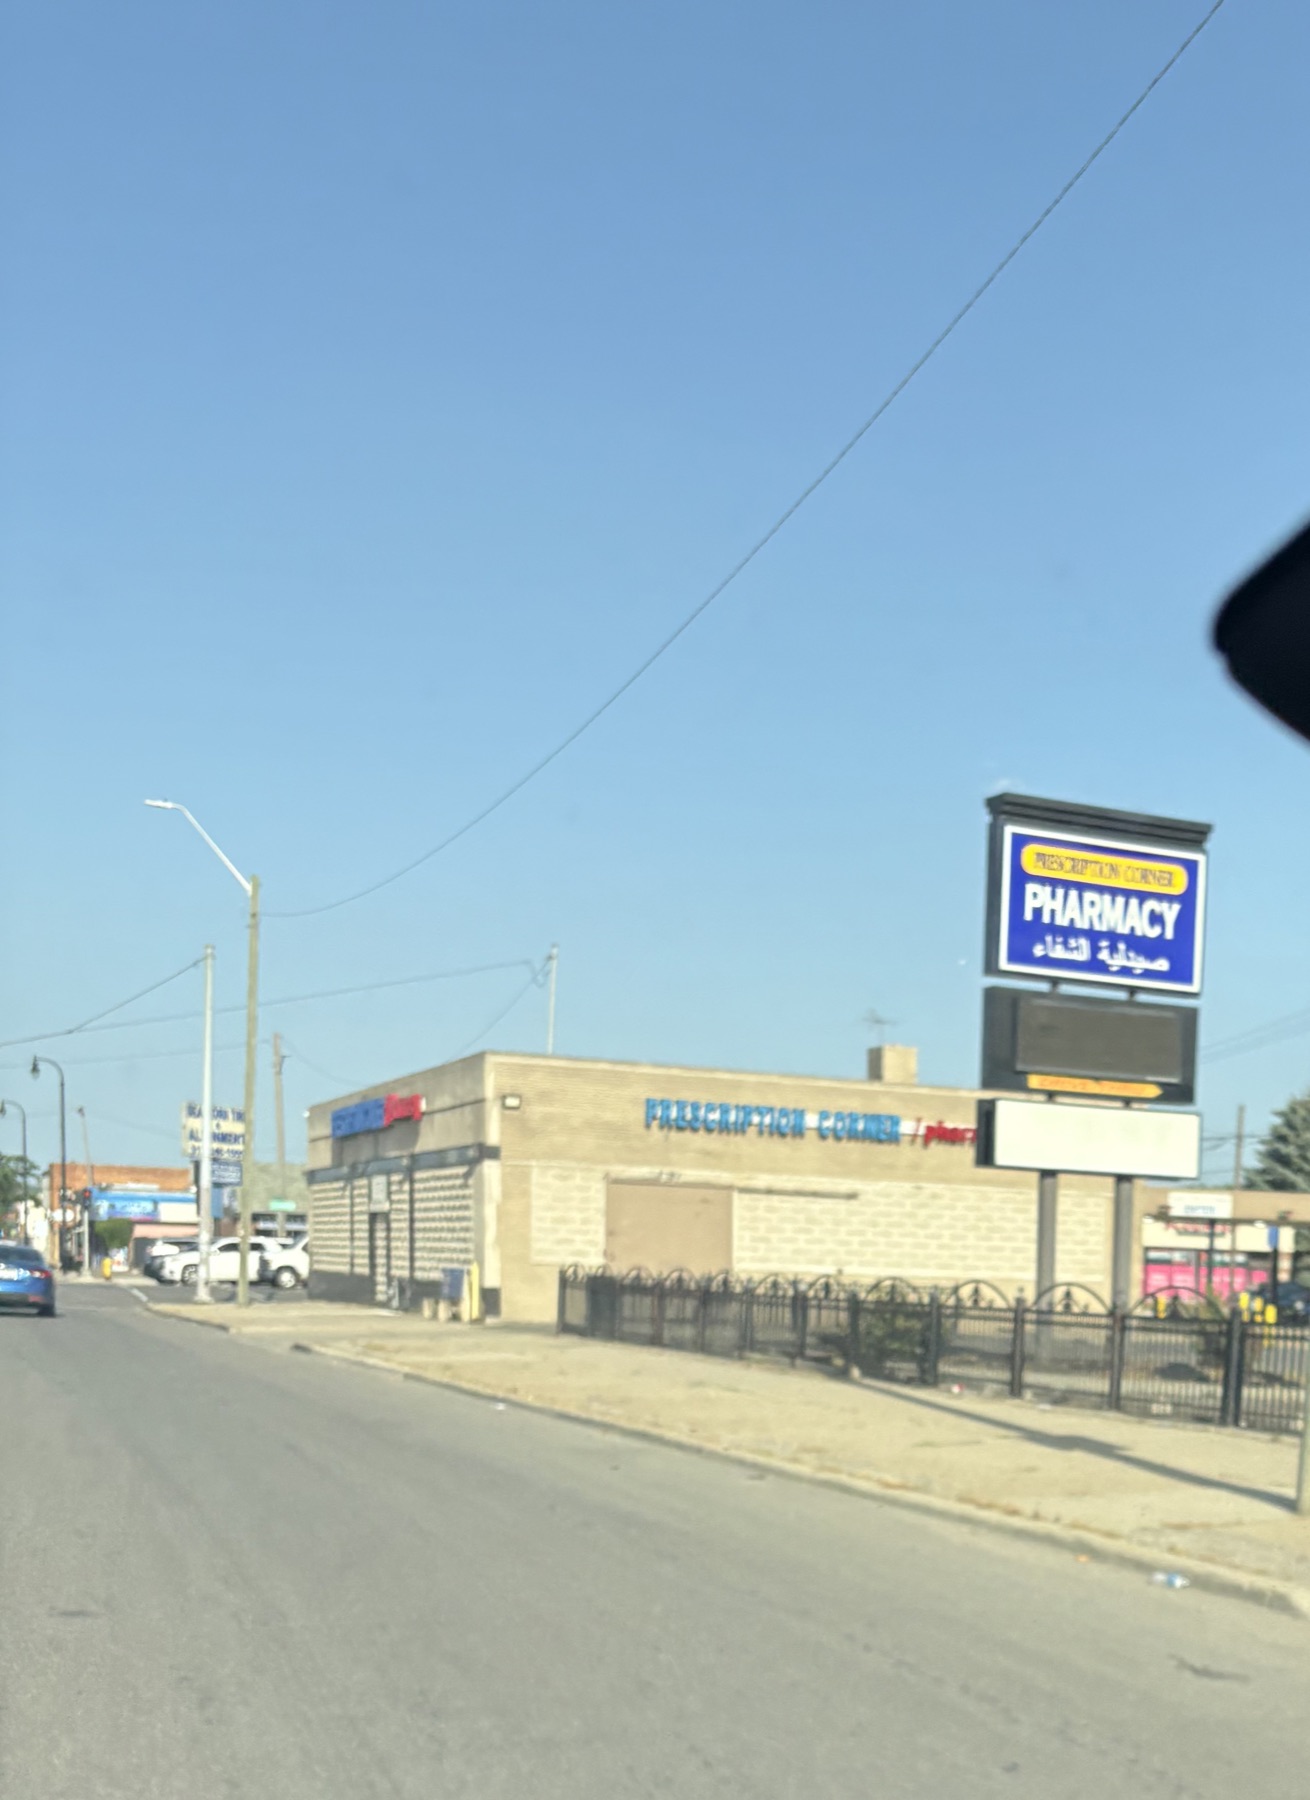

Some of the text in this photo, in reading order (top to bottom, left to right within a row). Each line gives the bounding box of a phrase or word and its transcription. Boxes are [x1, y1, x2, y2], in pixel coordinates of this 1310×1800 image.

[1034, 852, 1174, 887] PRESCRIPTION CORNER
[1023, 882, 1181, 940] PHARMACY
[645, 1098, 805, 1139] PRESCRIPTION
[818, 1110, 901, 1143] CORNER
